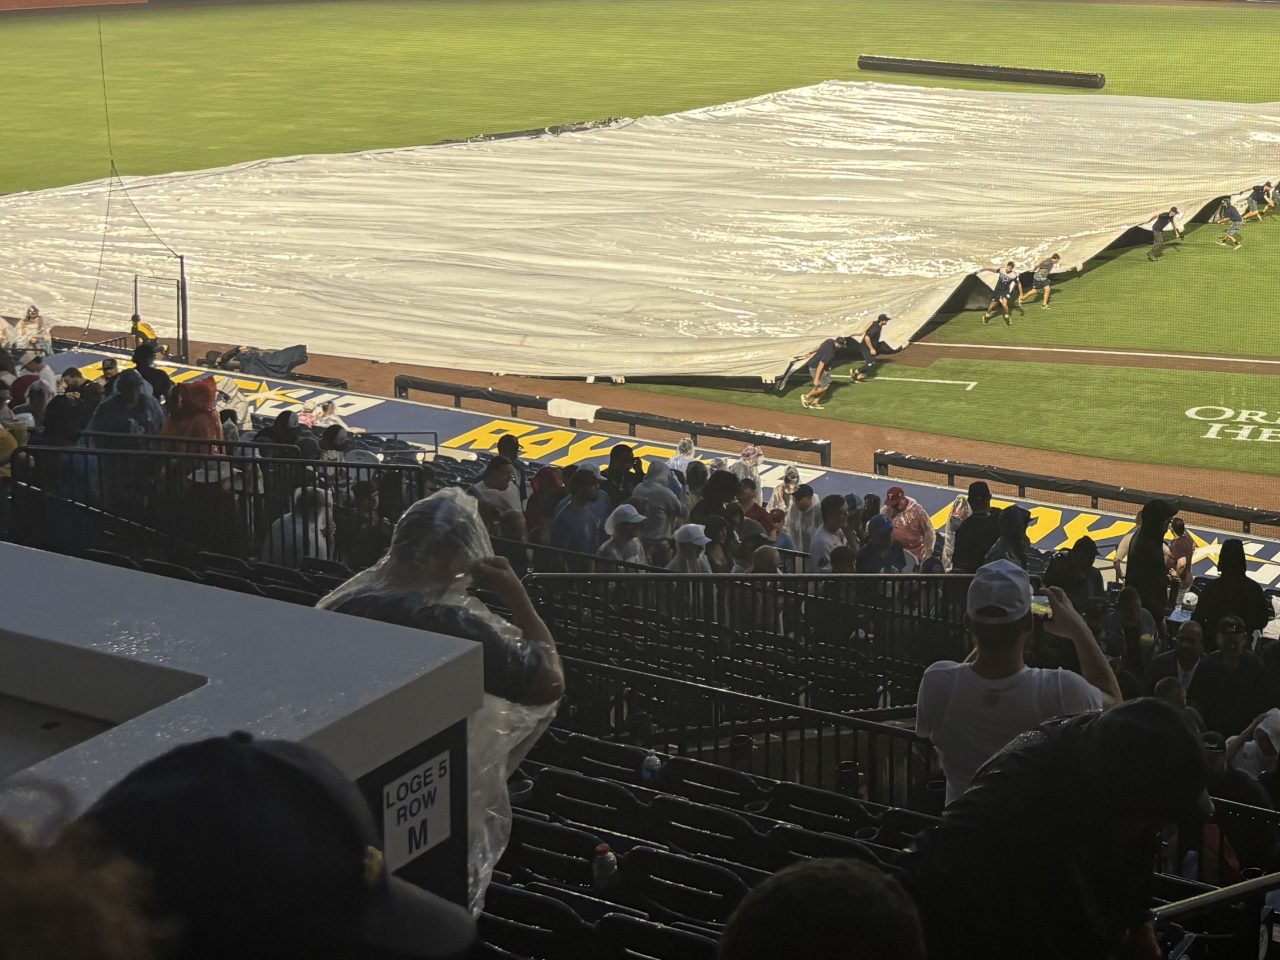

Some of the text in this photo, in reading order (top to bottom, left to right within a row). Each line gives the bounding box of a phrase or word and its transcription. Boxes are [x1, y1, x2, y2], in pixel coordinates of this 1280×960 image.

[385, 759, 448, 809] LOGE 5
[396, 787, 437, 826] ROW
[408, 818, 428, 854] M
